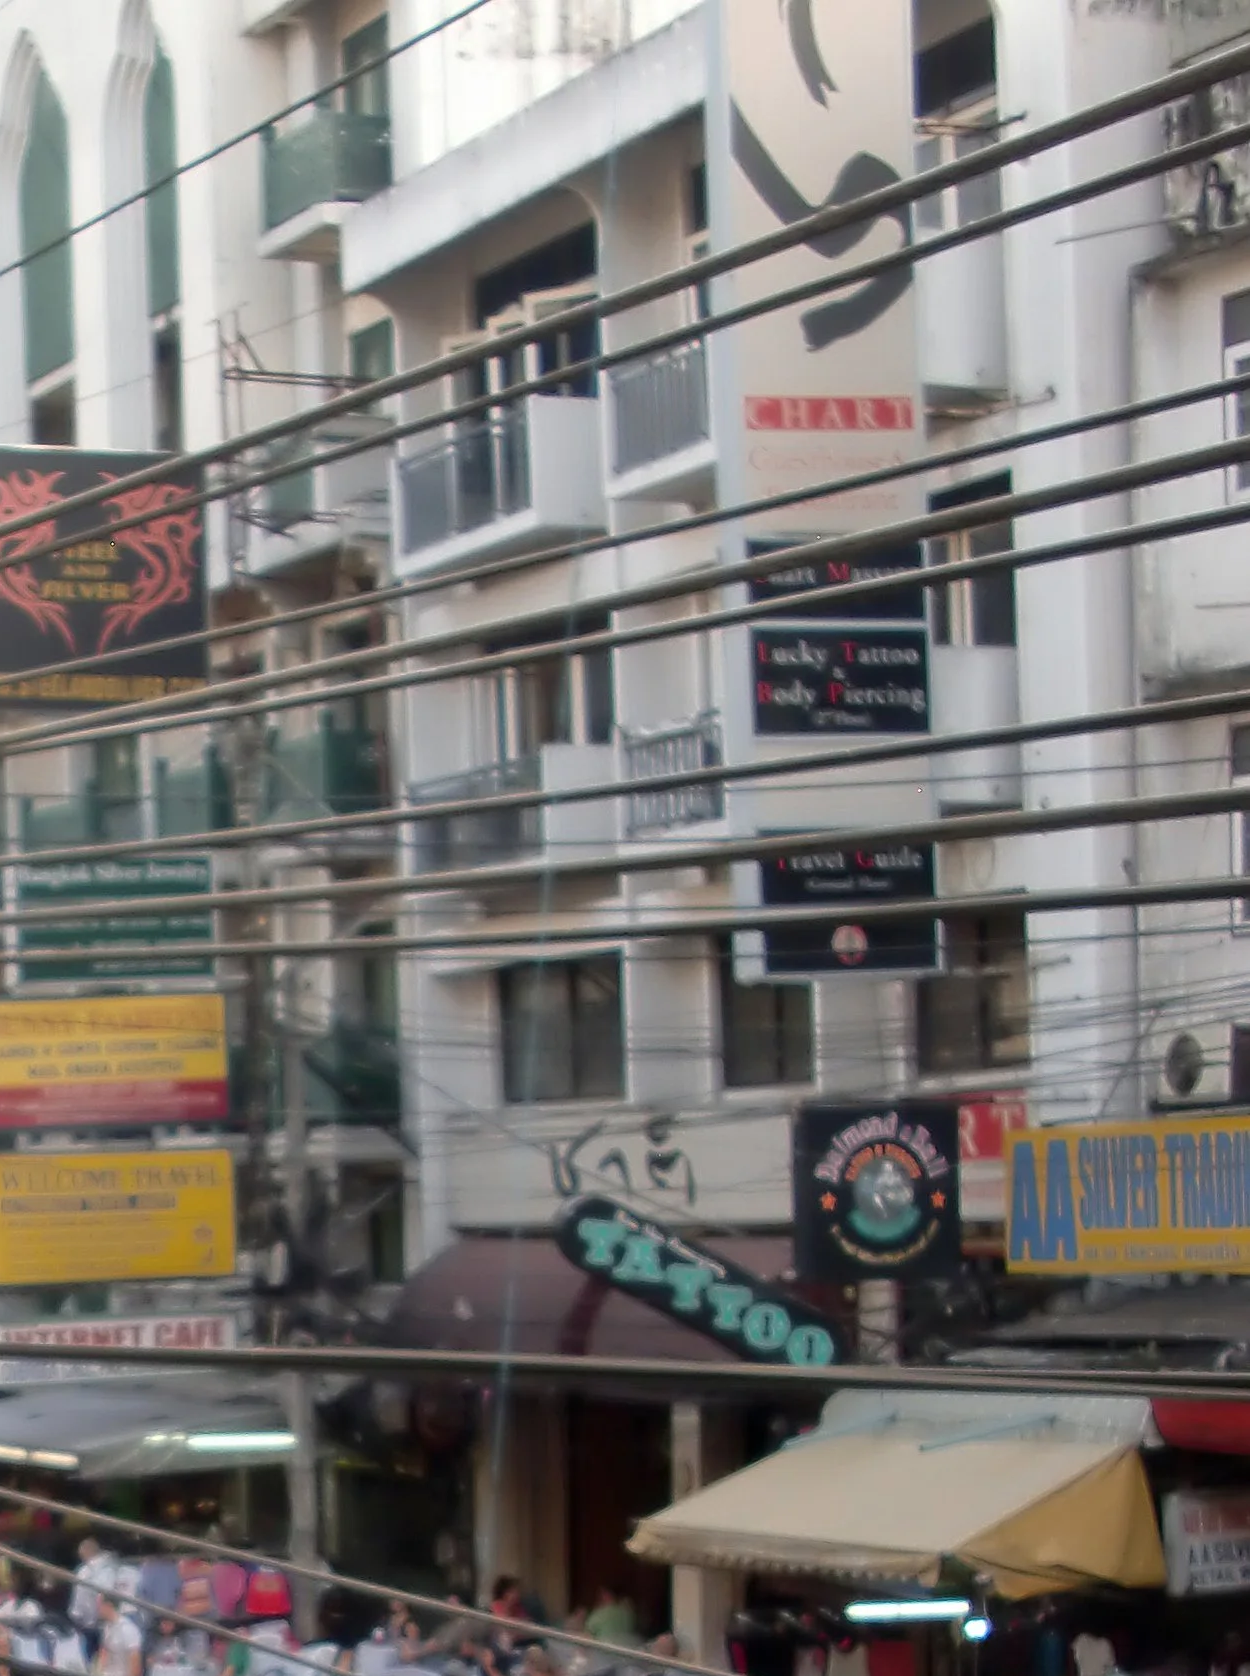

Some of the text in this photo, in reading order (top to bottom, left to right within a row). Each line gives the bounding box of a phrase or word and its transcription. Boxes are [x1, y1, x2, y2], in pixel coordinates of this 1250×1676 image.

[746, 398, 915, 430] CHART
[839, 640, 920, 665] Tattoo
[756, 679, 926, 713] Body Piercing
[855, 846, 923, 869] Guide
[1008, 1139, 1078, 1261] AA
[1078, 1134, 1159, 1230] SILVER
[577, 1217, 835, 1367] TATTOO
